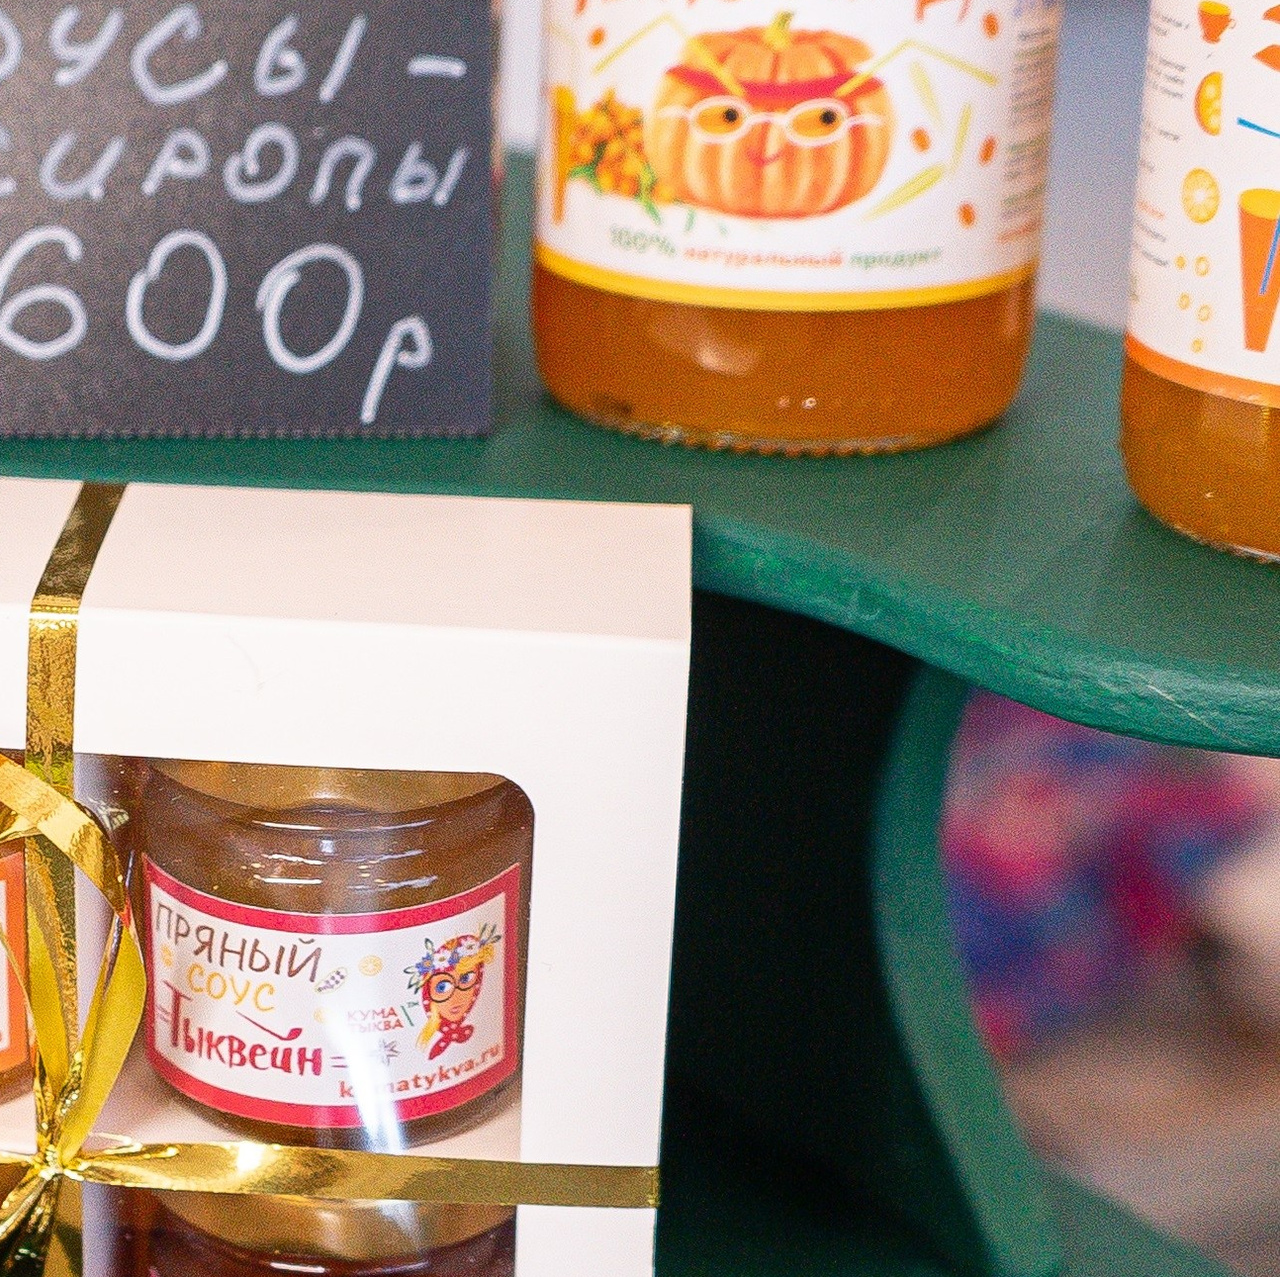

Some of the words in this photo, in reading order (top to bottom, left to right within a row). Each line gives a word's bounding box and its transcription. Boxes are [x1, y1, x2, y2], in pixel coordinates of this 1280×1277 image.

[156, 902, 322, 983] ПРЯНЫЙ
[187, 962, 276, 1012] СОУС
[338, 1044, 501, 1099] katykva.ru
